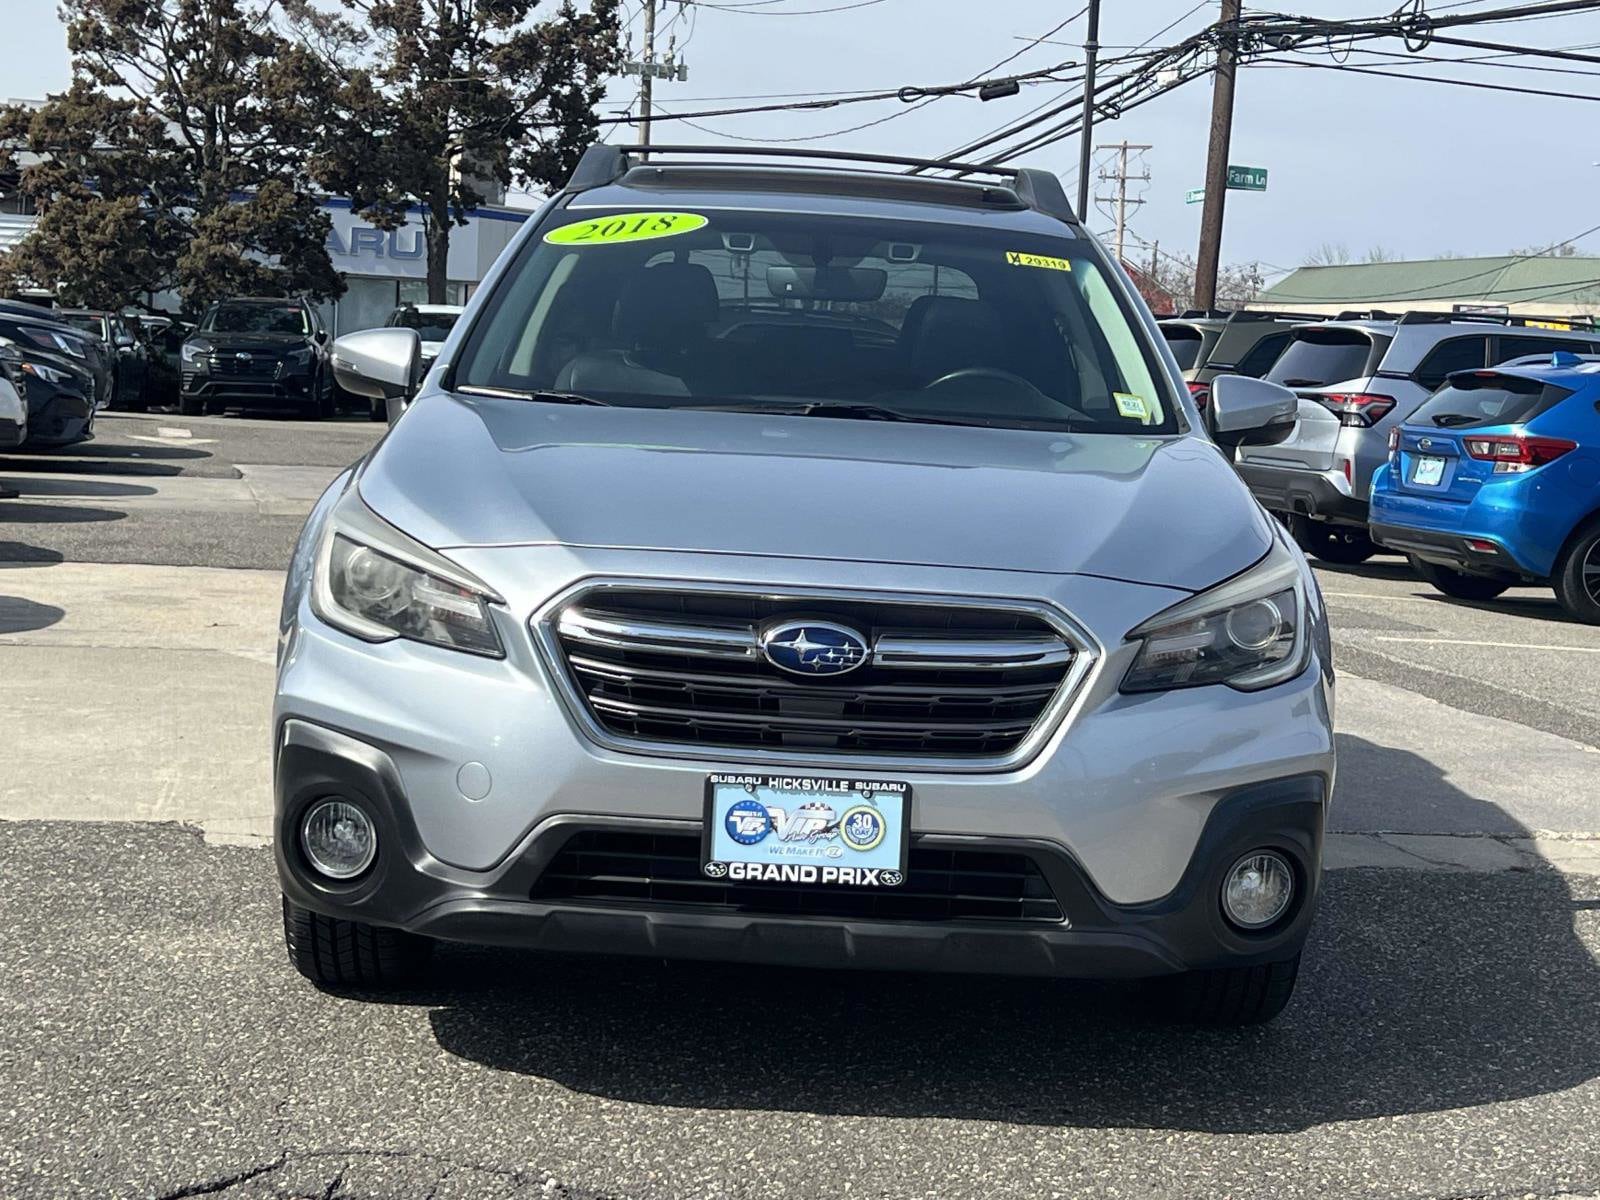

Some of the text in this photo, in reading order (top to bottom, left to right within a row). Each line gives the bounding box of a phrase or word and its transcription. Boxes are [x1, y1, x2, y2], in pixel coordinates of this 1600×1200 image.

[1229, 170, 1266, 185] Farm Ln
[573, 215, 679, 240] 2018
[710, 774, 907, 792] SUBARU HICKSVILLE SUBARU
[852, 813, 873, 829] 30
[728, 862, 880, 886] GRAND PRIX
